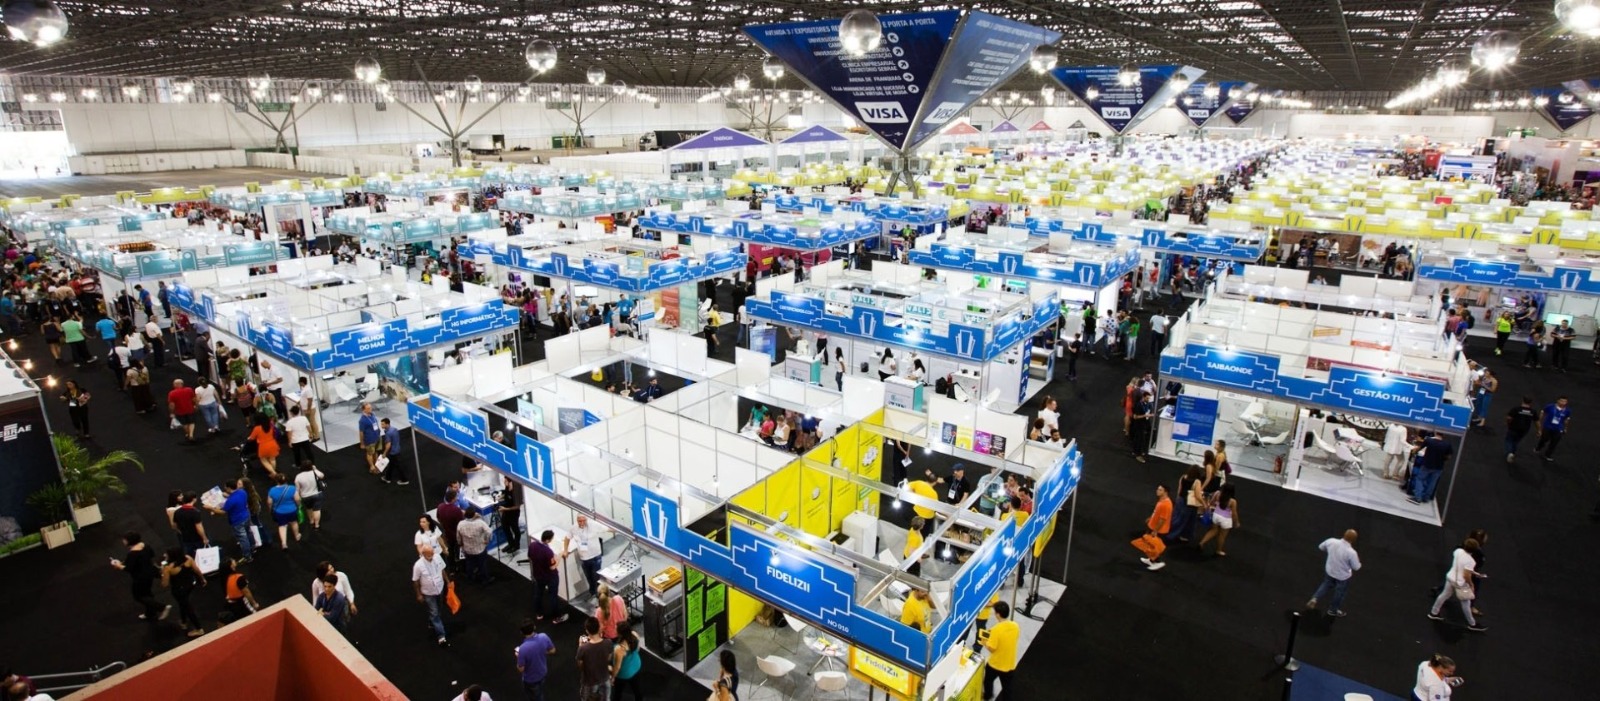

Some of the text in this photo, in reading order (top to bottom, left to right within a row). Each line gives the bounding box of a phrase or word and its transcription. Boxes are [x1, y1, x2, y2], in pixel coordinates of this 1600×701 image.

[888, 19, 909, 27] PORTA
[914, 18, 936, 26] PORTA
[795, 26, 831, 35] EXPOSITORES
[861, 107, 903, 119] VISA
[460, 313, 497, 326] INFORMÁTICA
[358, 333, 386, 344] MELHOR
[359, 340, 386, 351] DO MAR
[1206, 361, 1253, 375] SAIBAONDE
[1353, 387, 1414, 404] GESTÃO TI4U
[766, 565, 811, 593] FIDELIZII
[827, 618, 837, 627] NO
